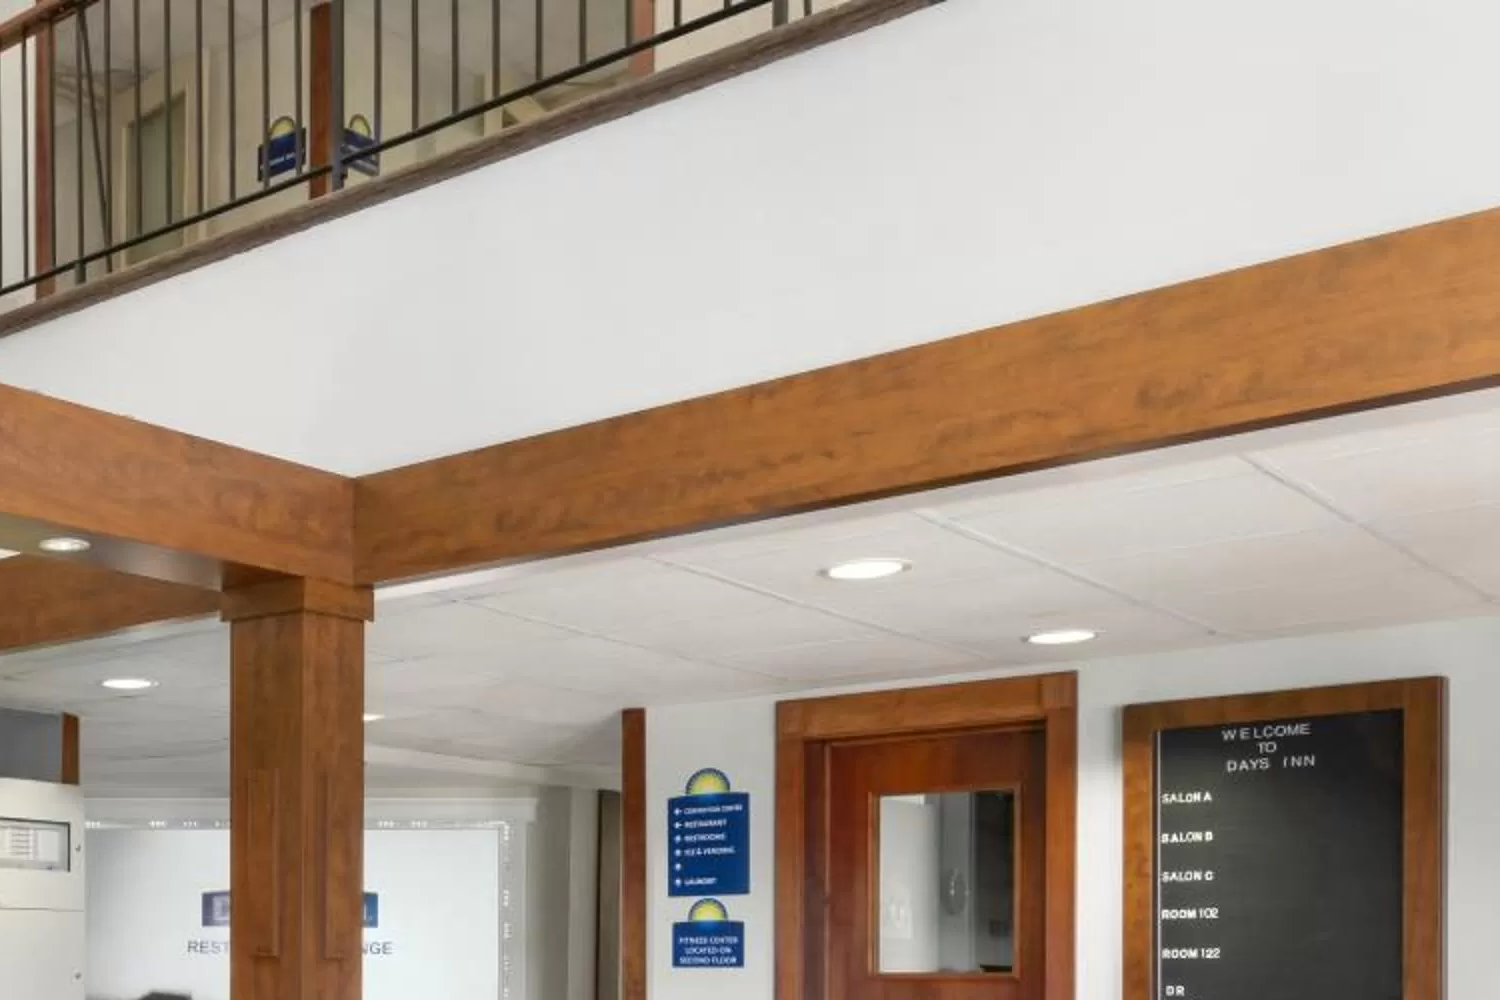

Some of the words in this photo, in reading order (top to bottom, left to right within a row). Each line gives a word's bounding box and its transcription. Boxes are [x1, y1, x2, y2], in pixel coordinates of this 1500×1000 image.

[1221, 722, 1312, 741] WELCOME
[1257, 741, 1277, 753] TO
[1226, 757, 1271, 773] DAYS
[1283, 755, 1316, 769] INN
[1161, 792, 1201, 804] SALON
[1203, 791, 1213, 802] A
[1160, 831, 1203, 844] SALON
[1205, 831, 1214, 842] B
[1161, 870, 1203, 883] SALON
[1160, 908, 1197, 920] ROOM
[1198, 907, 1219, 919] 102
[1161, 948, 1199, 959] ROOM
[1201, 947, 1221, 959] 122
